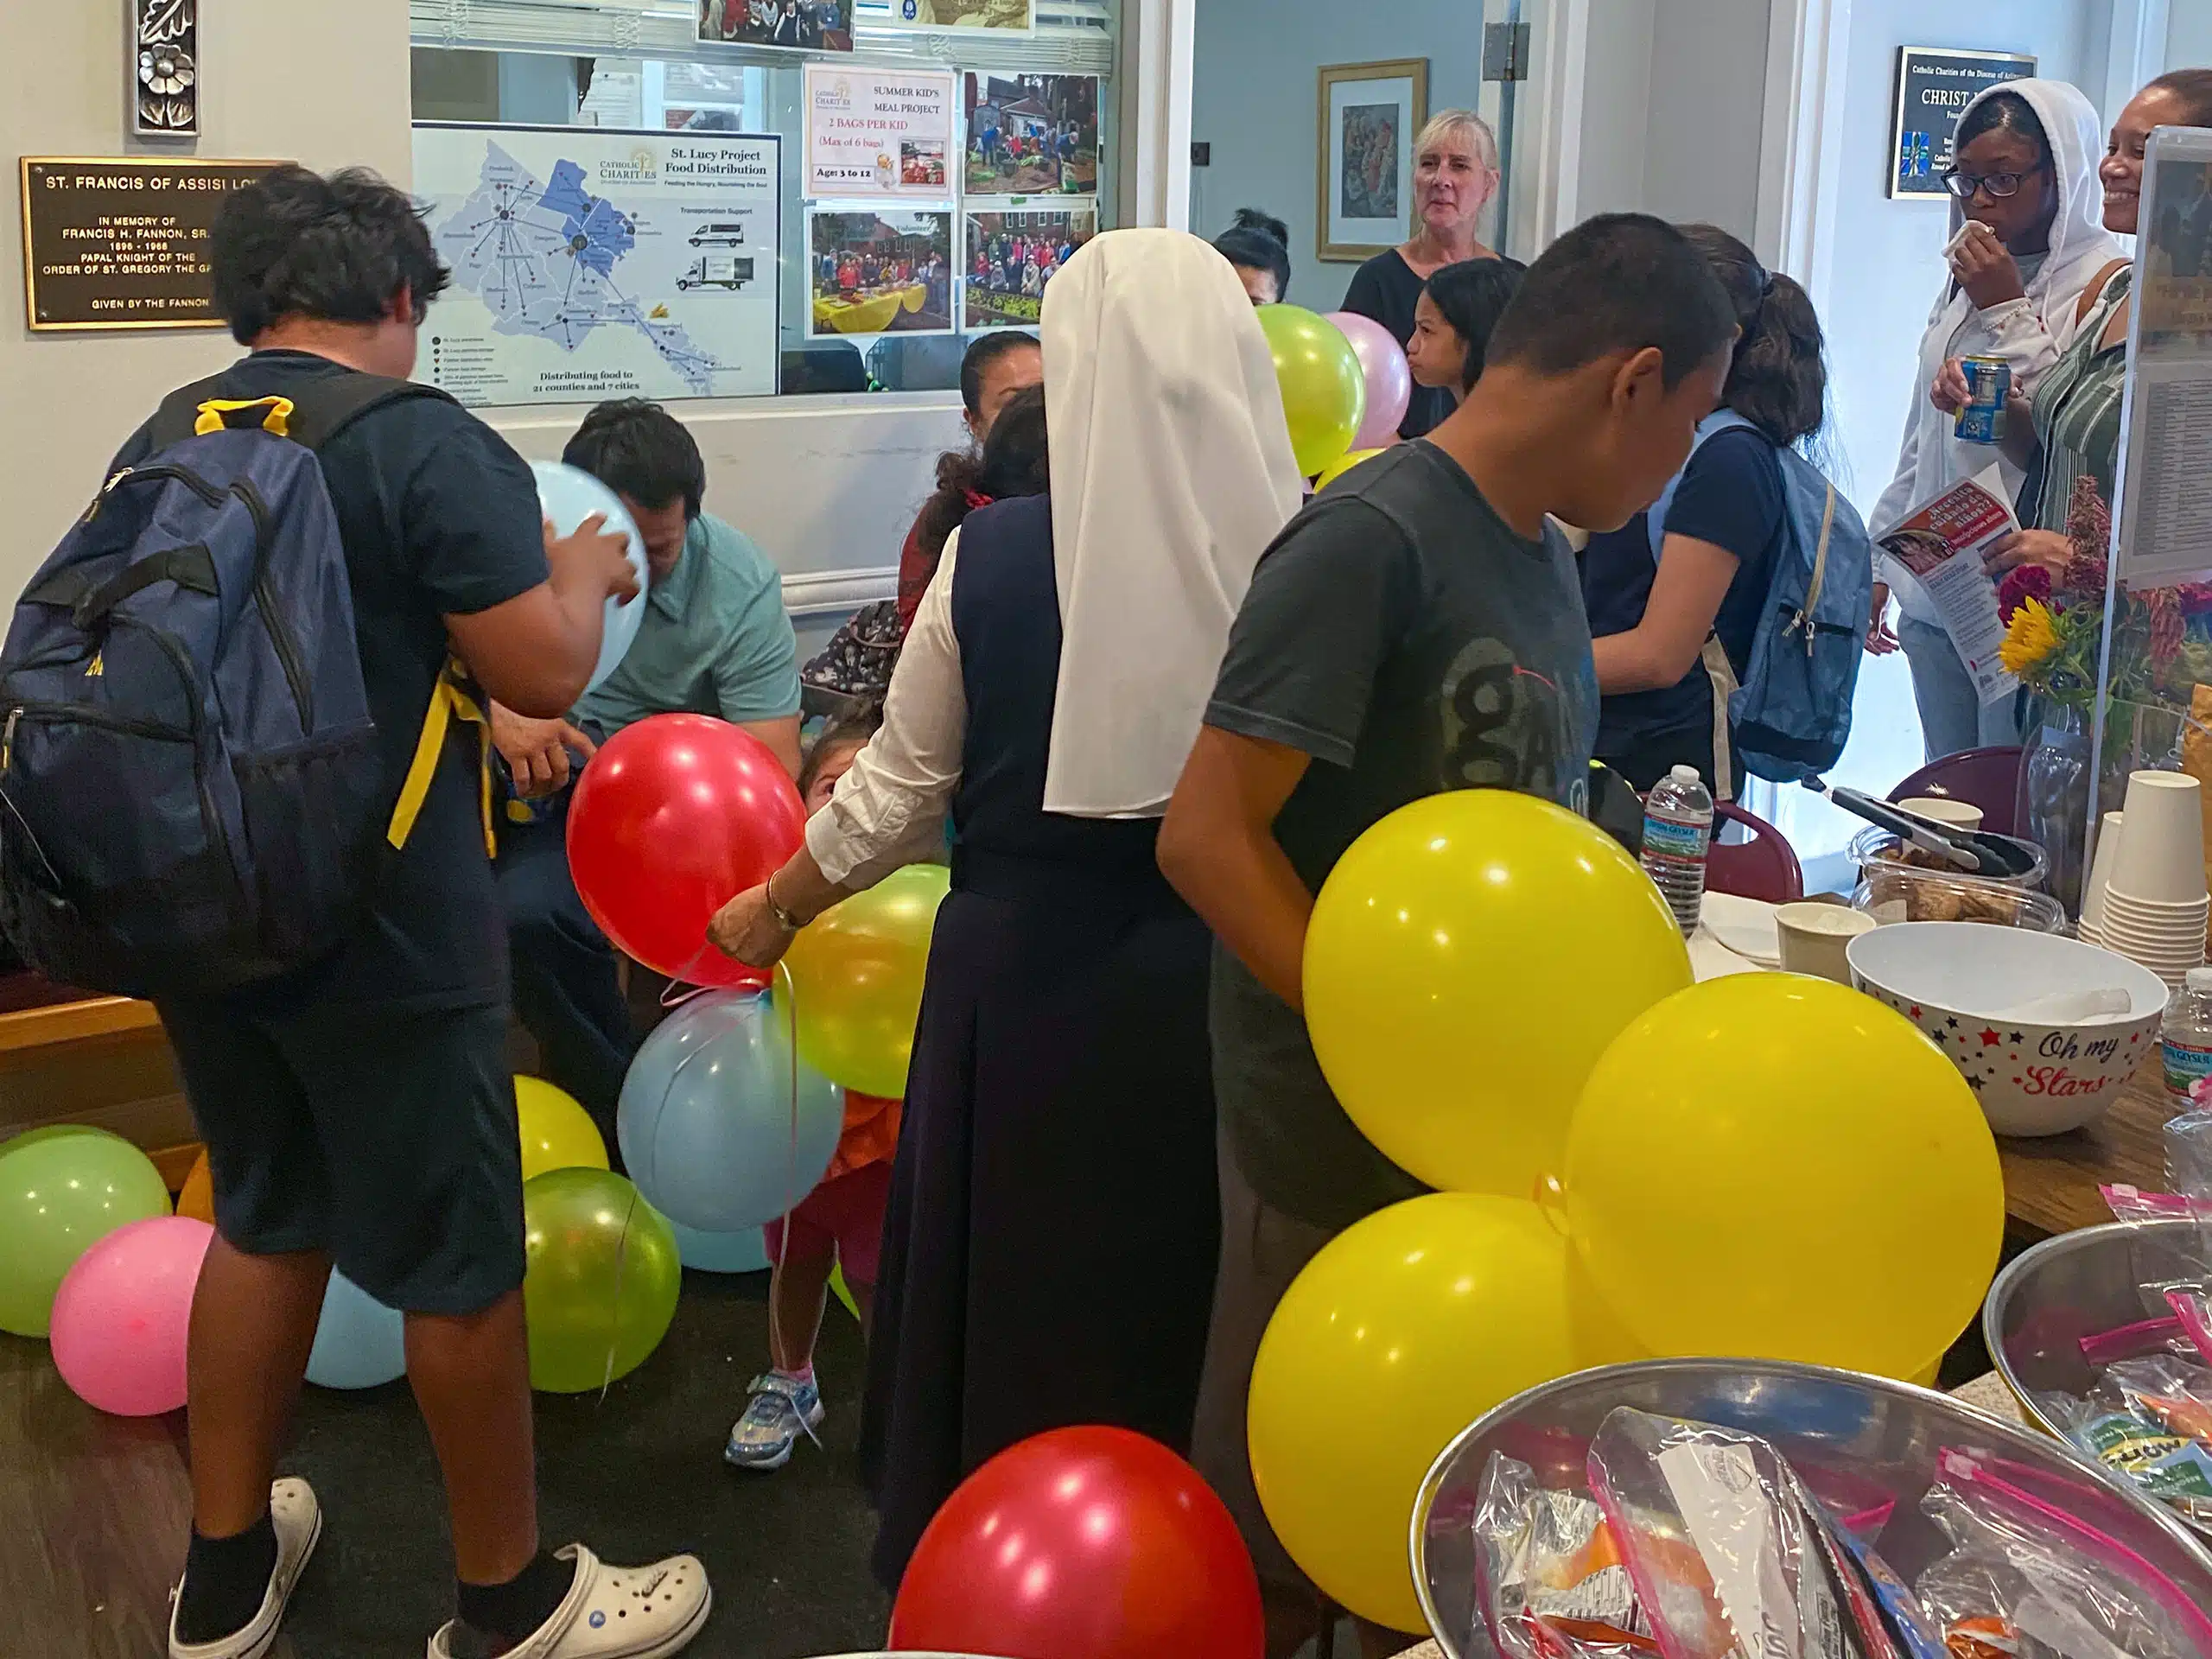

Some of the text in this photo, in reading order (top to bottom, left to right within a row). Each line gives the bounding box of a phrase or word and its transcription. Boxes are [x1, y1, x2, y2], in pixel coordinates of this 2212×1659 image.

[1912, 65, 1934, 75] Catholic
[1936, 67, 1958, 77] Charities
[1960, 67, 1966, 77] of
[1967, 68, 1975, 78] the
[874, 86, 940, 98] SUMMER KID'S
[1922, 88, 1968, 106] CHRIST
[874, 103, 940, 114] MEAL PROJECT
[829, 118, 908, 130] 2 BAGS PER KID
[819, 136, 884, 149] (Max of 6 bags)
[671, 149, 761, 162] St. Lucy Project
[665, 162, 767, 175] Food Distribution
[840, 169, 845, 178] 3
[46, 176, 69, 189] ST.
[76, 176, 144, 190] FRANCIS
[149, 177, 171, 190] OF
[177, 178, 226, 190] ASSISI
[99, 217, 176, 226] IN MEMORY OF
[62, 229, 211, 240] FRANCIS H. FANNON, SR.
[80, 252, 195, 263] PAPAL KNIGHT OF THE
[42, 265, 80, 275] ORDER
[84, 265, 99, 274] OF
[102, 264, 118, 274] ST.
[122, 264, 172, 274] GREGORY
[175, 264, 195, 273] THE
[92, 298, 209, 309] GIVEN BY THE FANNON
[540, 371, 632, 382] Distributing food to
[544, 383, 586, 392] counties
[588, 382, 606, 391] and
[2038, 1031, 2120, 1064] Oh my
[2023, 1065, 2106, 1096] Stars
